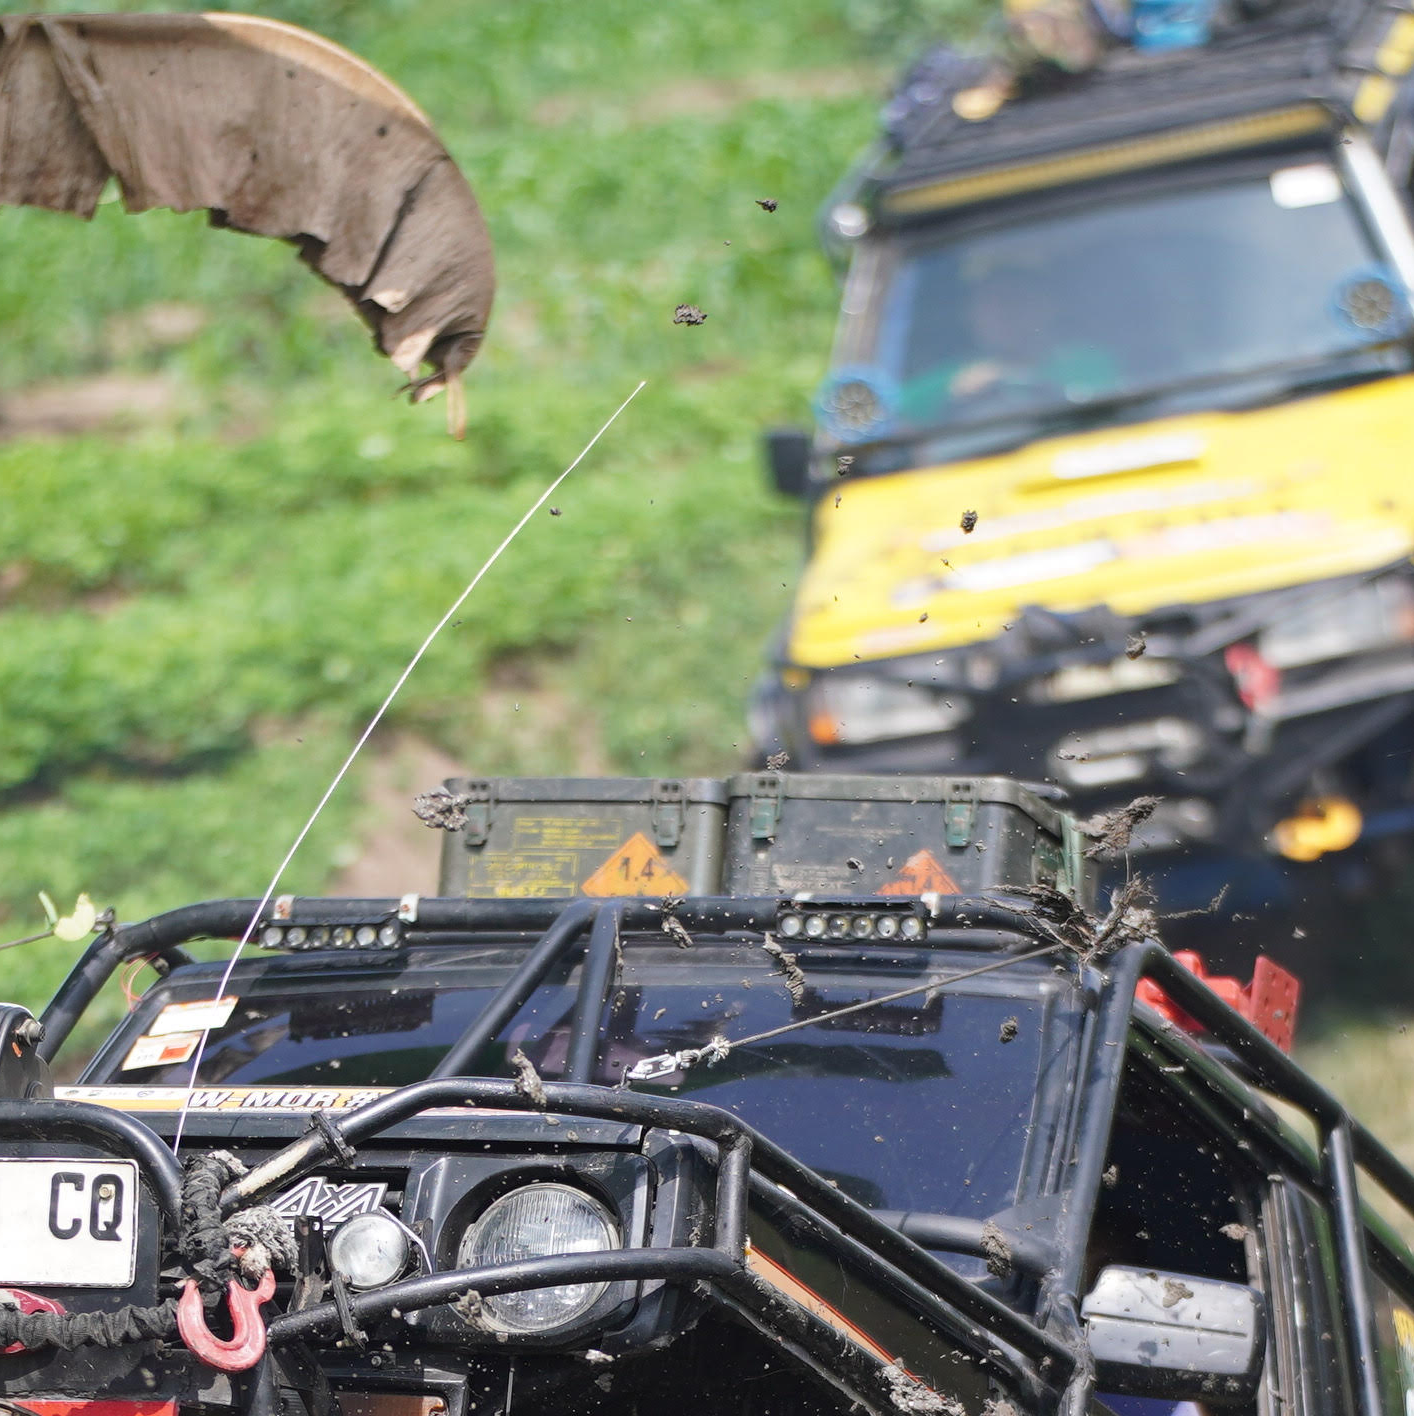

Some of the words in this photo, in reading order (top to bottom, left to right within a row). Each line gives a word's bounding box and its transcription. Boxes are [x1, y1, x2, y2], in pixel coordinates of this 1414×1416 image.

[621, 856, 655, 882] 1.4
[188, 1090, 341, 1108] W-MOR
[47, 1172, 125, 1242] CQ
